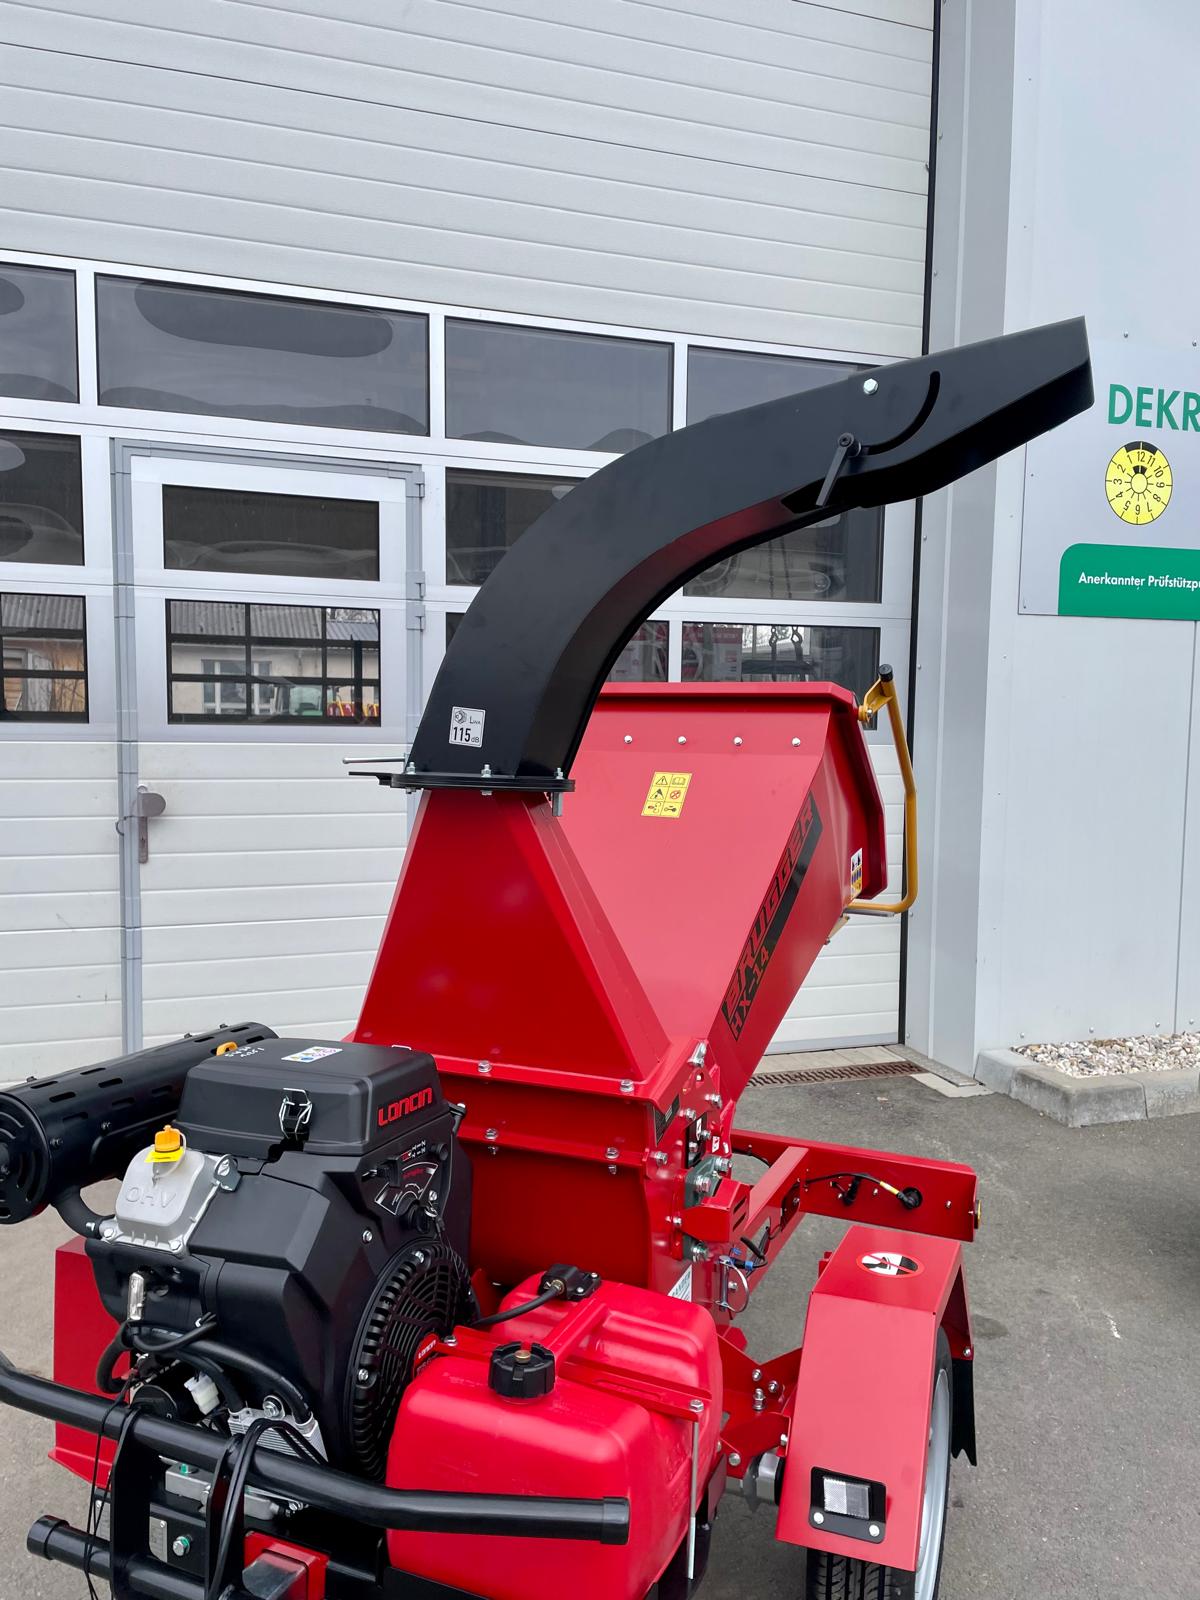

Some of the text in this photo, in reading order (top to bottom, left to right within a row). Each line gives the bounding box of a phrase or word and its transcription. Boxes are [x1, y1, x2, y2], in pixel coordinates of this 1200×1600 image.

[1108, 384, 1200, 432] DEKR
[1127, 454, 1133, 464] 1
[1137, 451, 1146, 463] 12
[1146, 455, 1156, 467] 11
[1117, 464, 1126, 473] 2
[1153, 465, 1164, 478] 10
[1152, 493, 1161, 502] 8
[1123, 500, 1131, 511] 5
[1078, 572, 1146, 587] Anerkannter
[453, 727, 471, 742] 115
[730, 945, 769, 1037] HX-14
[126, 1187, 177, 1209] OHV
